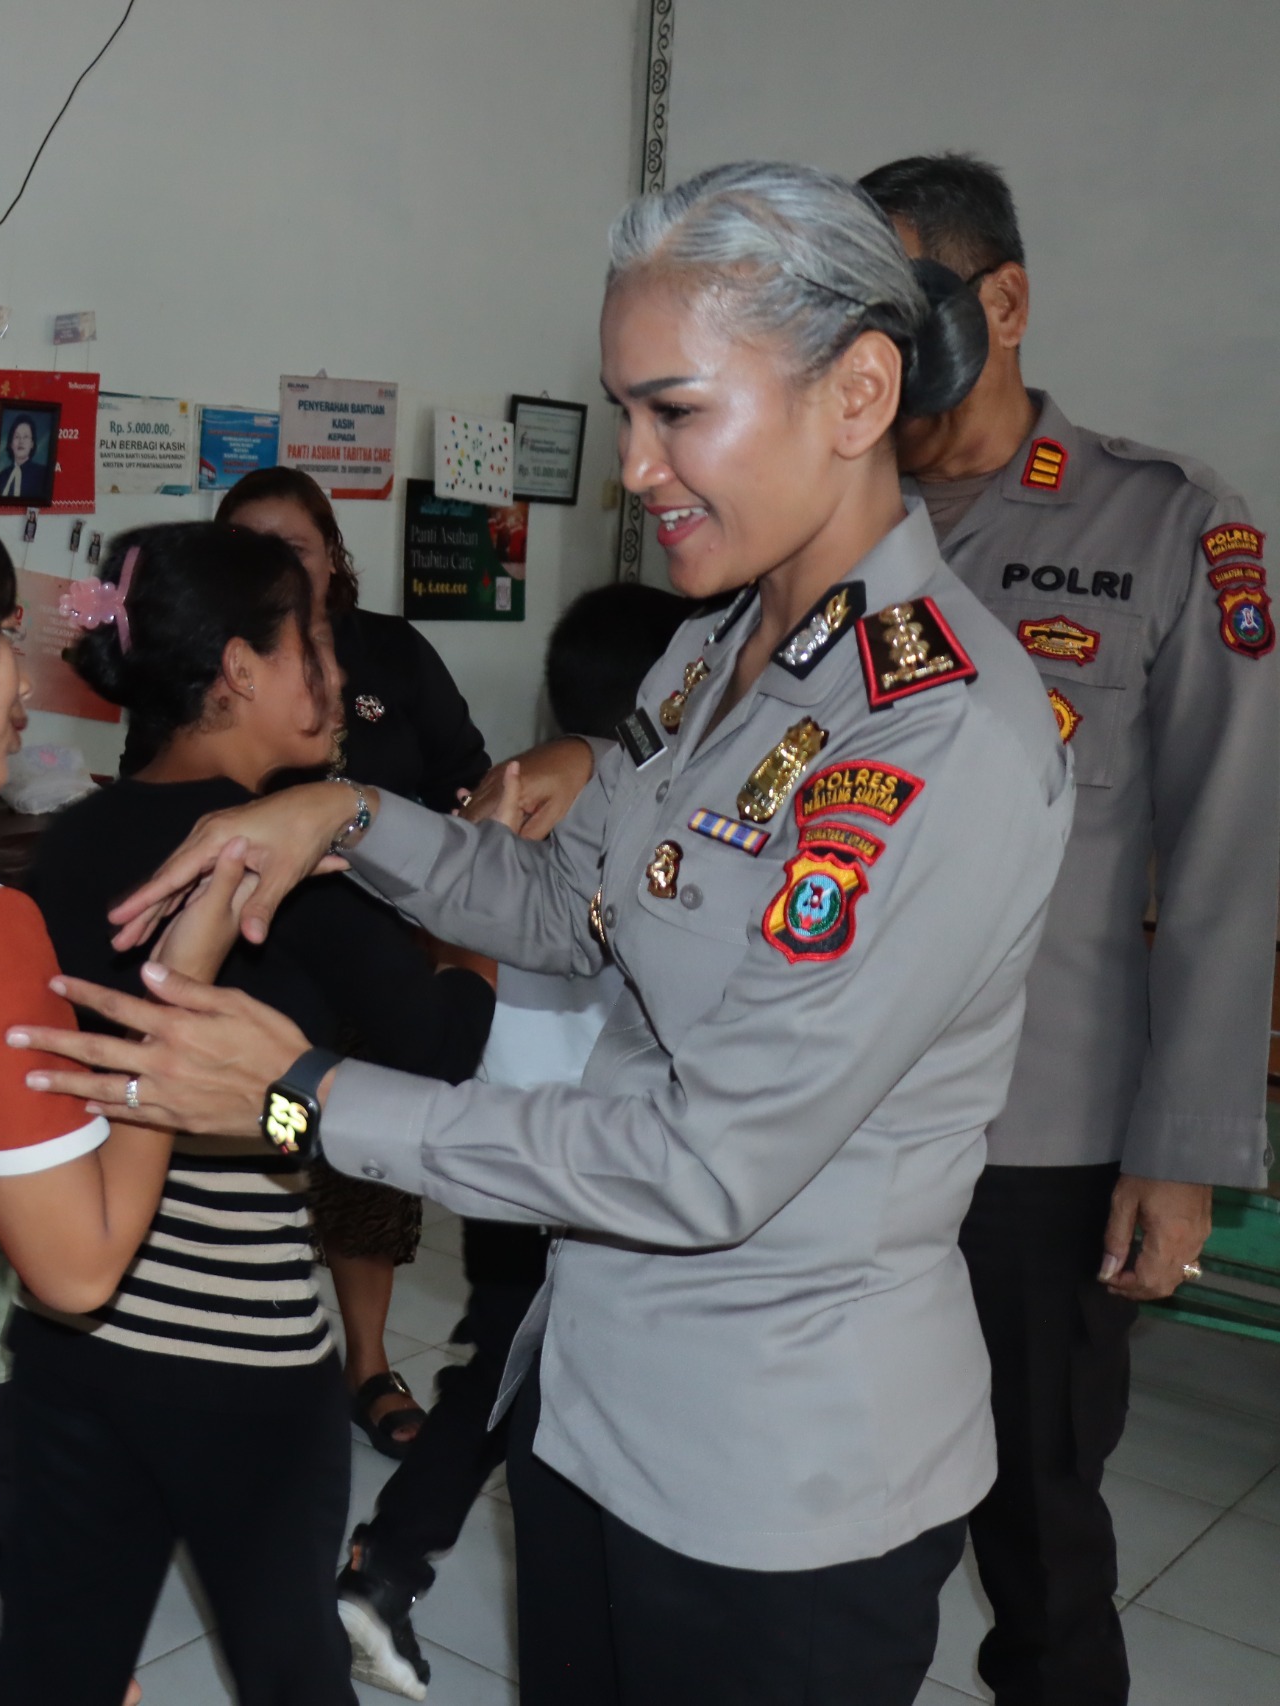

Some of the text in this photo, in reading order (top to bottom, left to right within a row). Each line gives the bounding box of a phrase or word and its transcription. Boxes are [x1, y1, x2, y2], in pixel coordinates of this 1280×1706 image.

[298, 400, 385, 415] PENYERAHAN BANTUAN
[109, 420, 125, 436] Rp.
[332, 418, 355, 430] KASIH
[58, 428, 79, 439] 2022
[327, 432, 356, 441] KEPADA
[99, 439, 186, 451] PLN BERBAGI KASIH
[287, 444, 309, 459] PANTI
[311, 445, 341, 460] ASUHAN
[373, 447, 392, 463] CARE
[410, 524, 479, 546] Panti Asuhan
[1207, 528, 1259, 551] POLRES
[411, 548, 476, 571] Thabita Care
[1001, 562, 1134, 601] POLRI
[812, 767, 899, 799] POLRES
